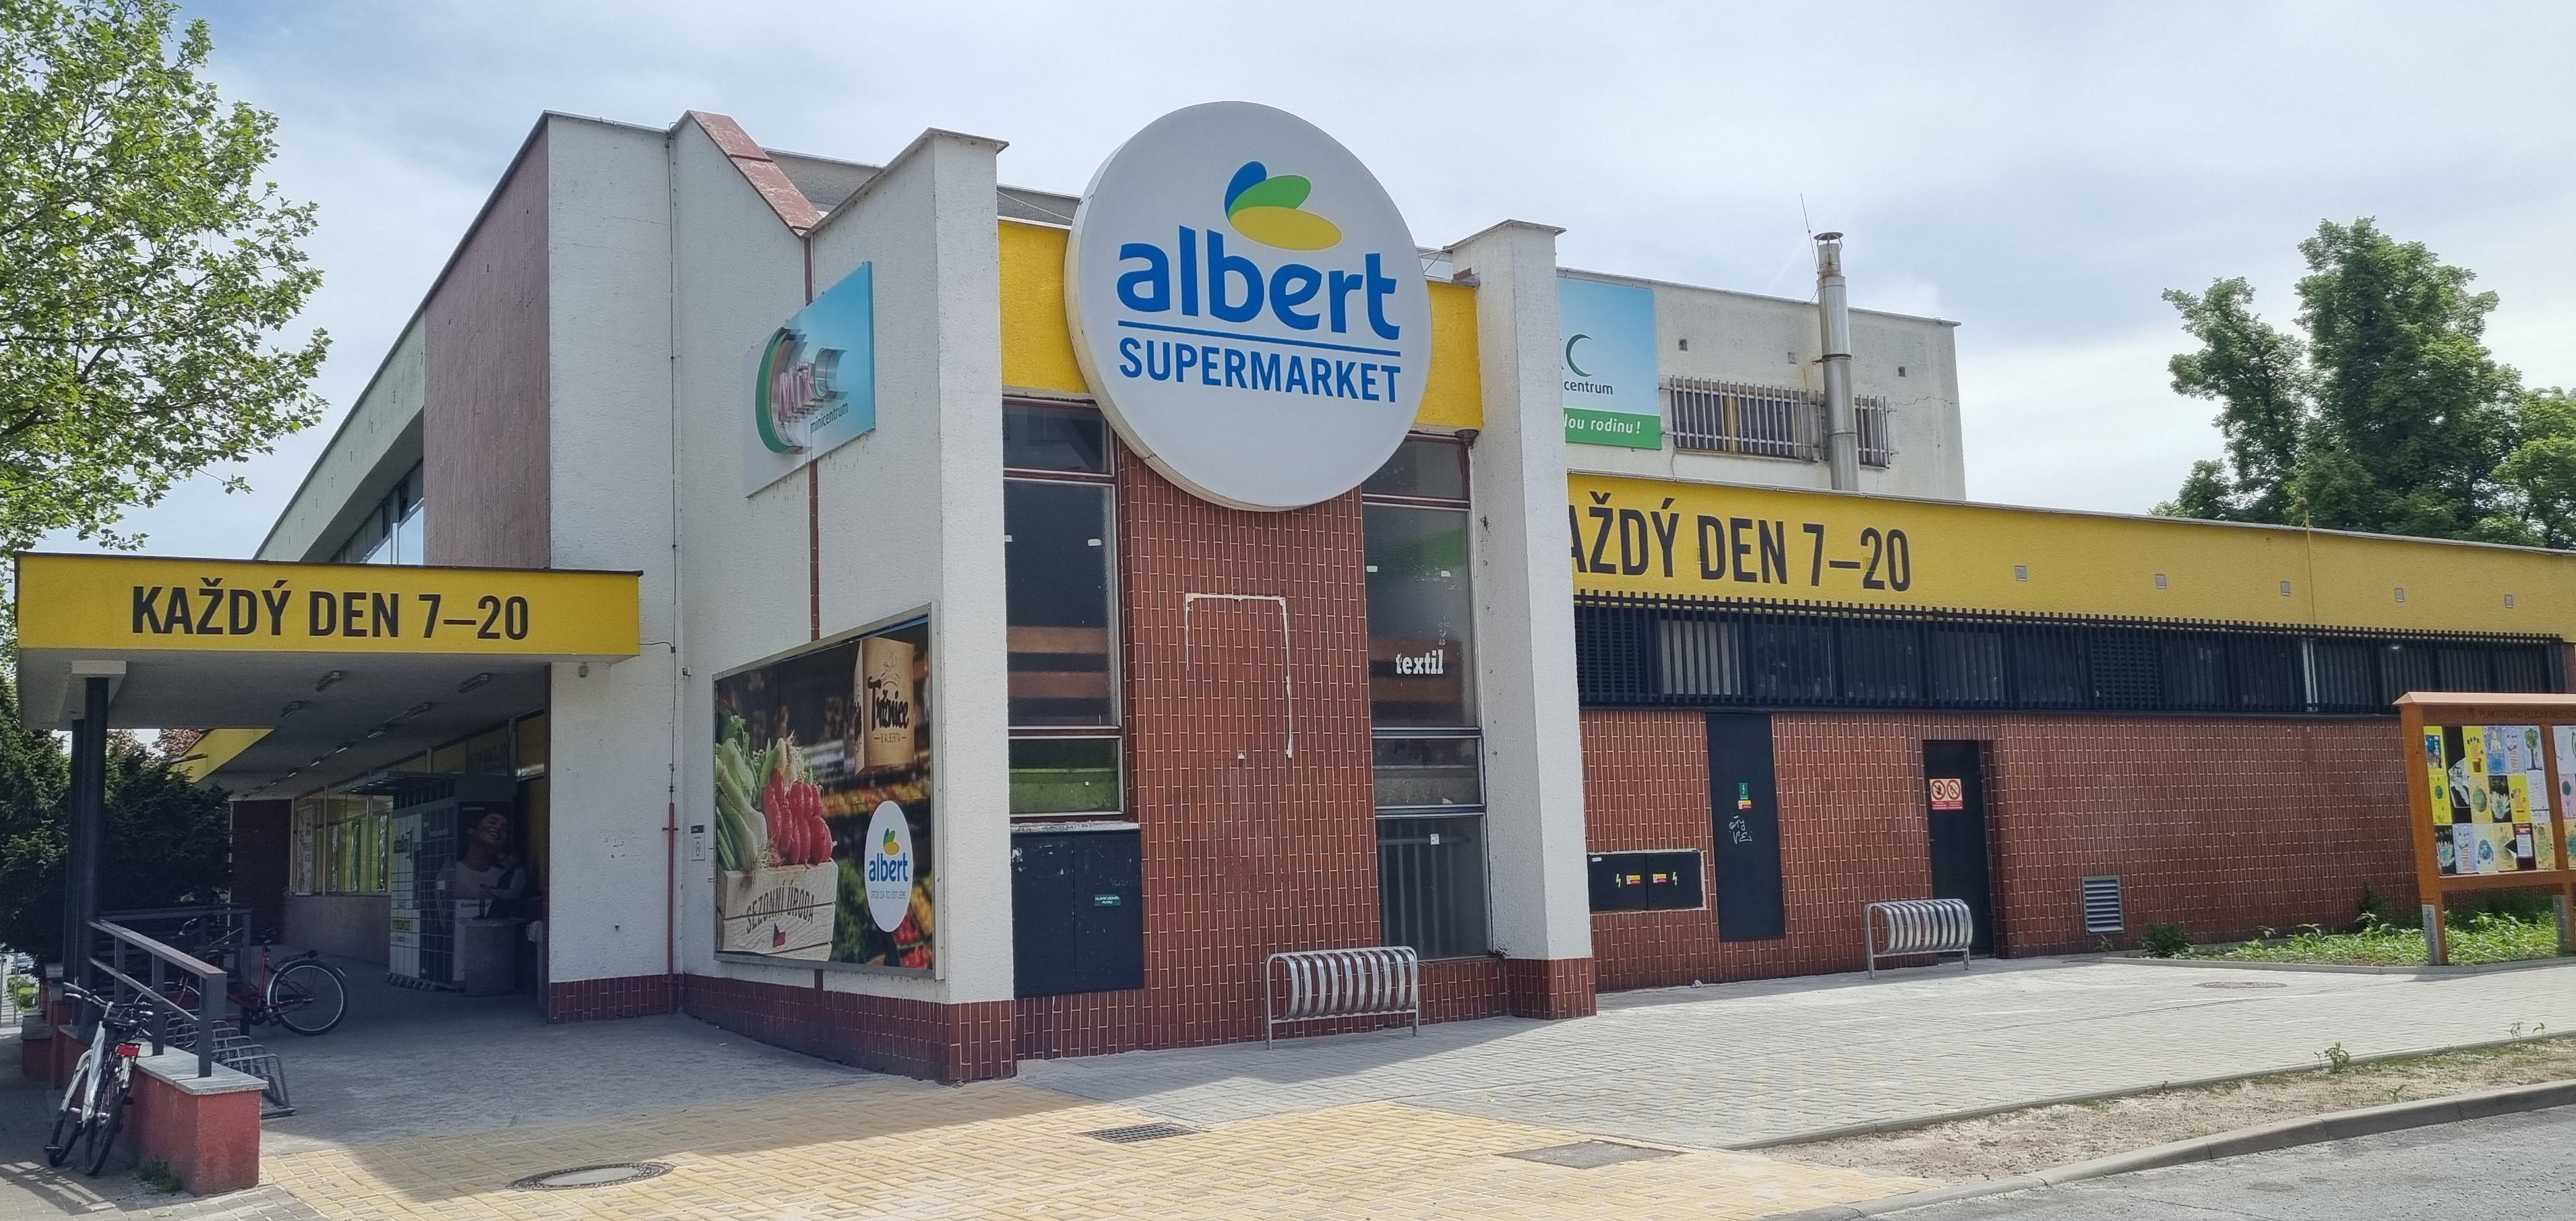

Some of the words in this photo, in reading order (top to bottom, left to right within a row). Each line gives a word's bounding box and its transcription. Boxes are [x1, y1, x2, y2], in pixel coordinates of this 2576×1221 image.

[1116, 225, 1401, 341] albert
[1119, 337, 1401, 403] SUPERMARKET
[1564, 381, 1614, 395] centrum
[810, 403, 848, 434] minicentrum
[1697, 515, 1787, 585] DEN
[132, 577, 292, 636] KAŽDÝ
[309, 591, 399, 637] DEN
[1395, 650, 1444, 675] textil
[869, 852, 908, 882] albert
[747, 879, 785, 934] SEZONNÍ
[787, 879, 814, 924] ÚRODA
